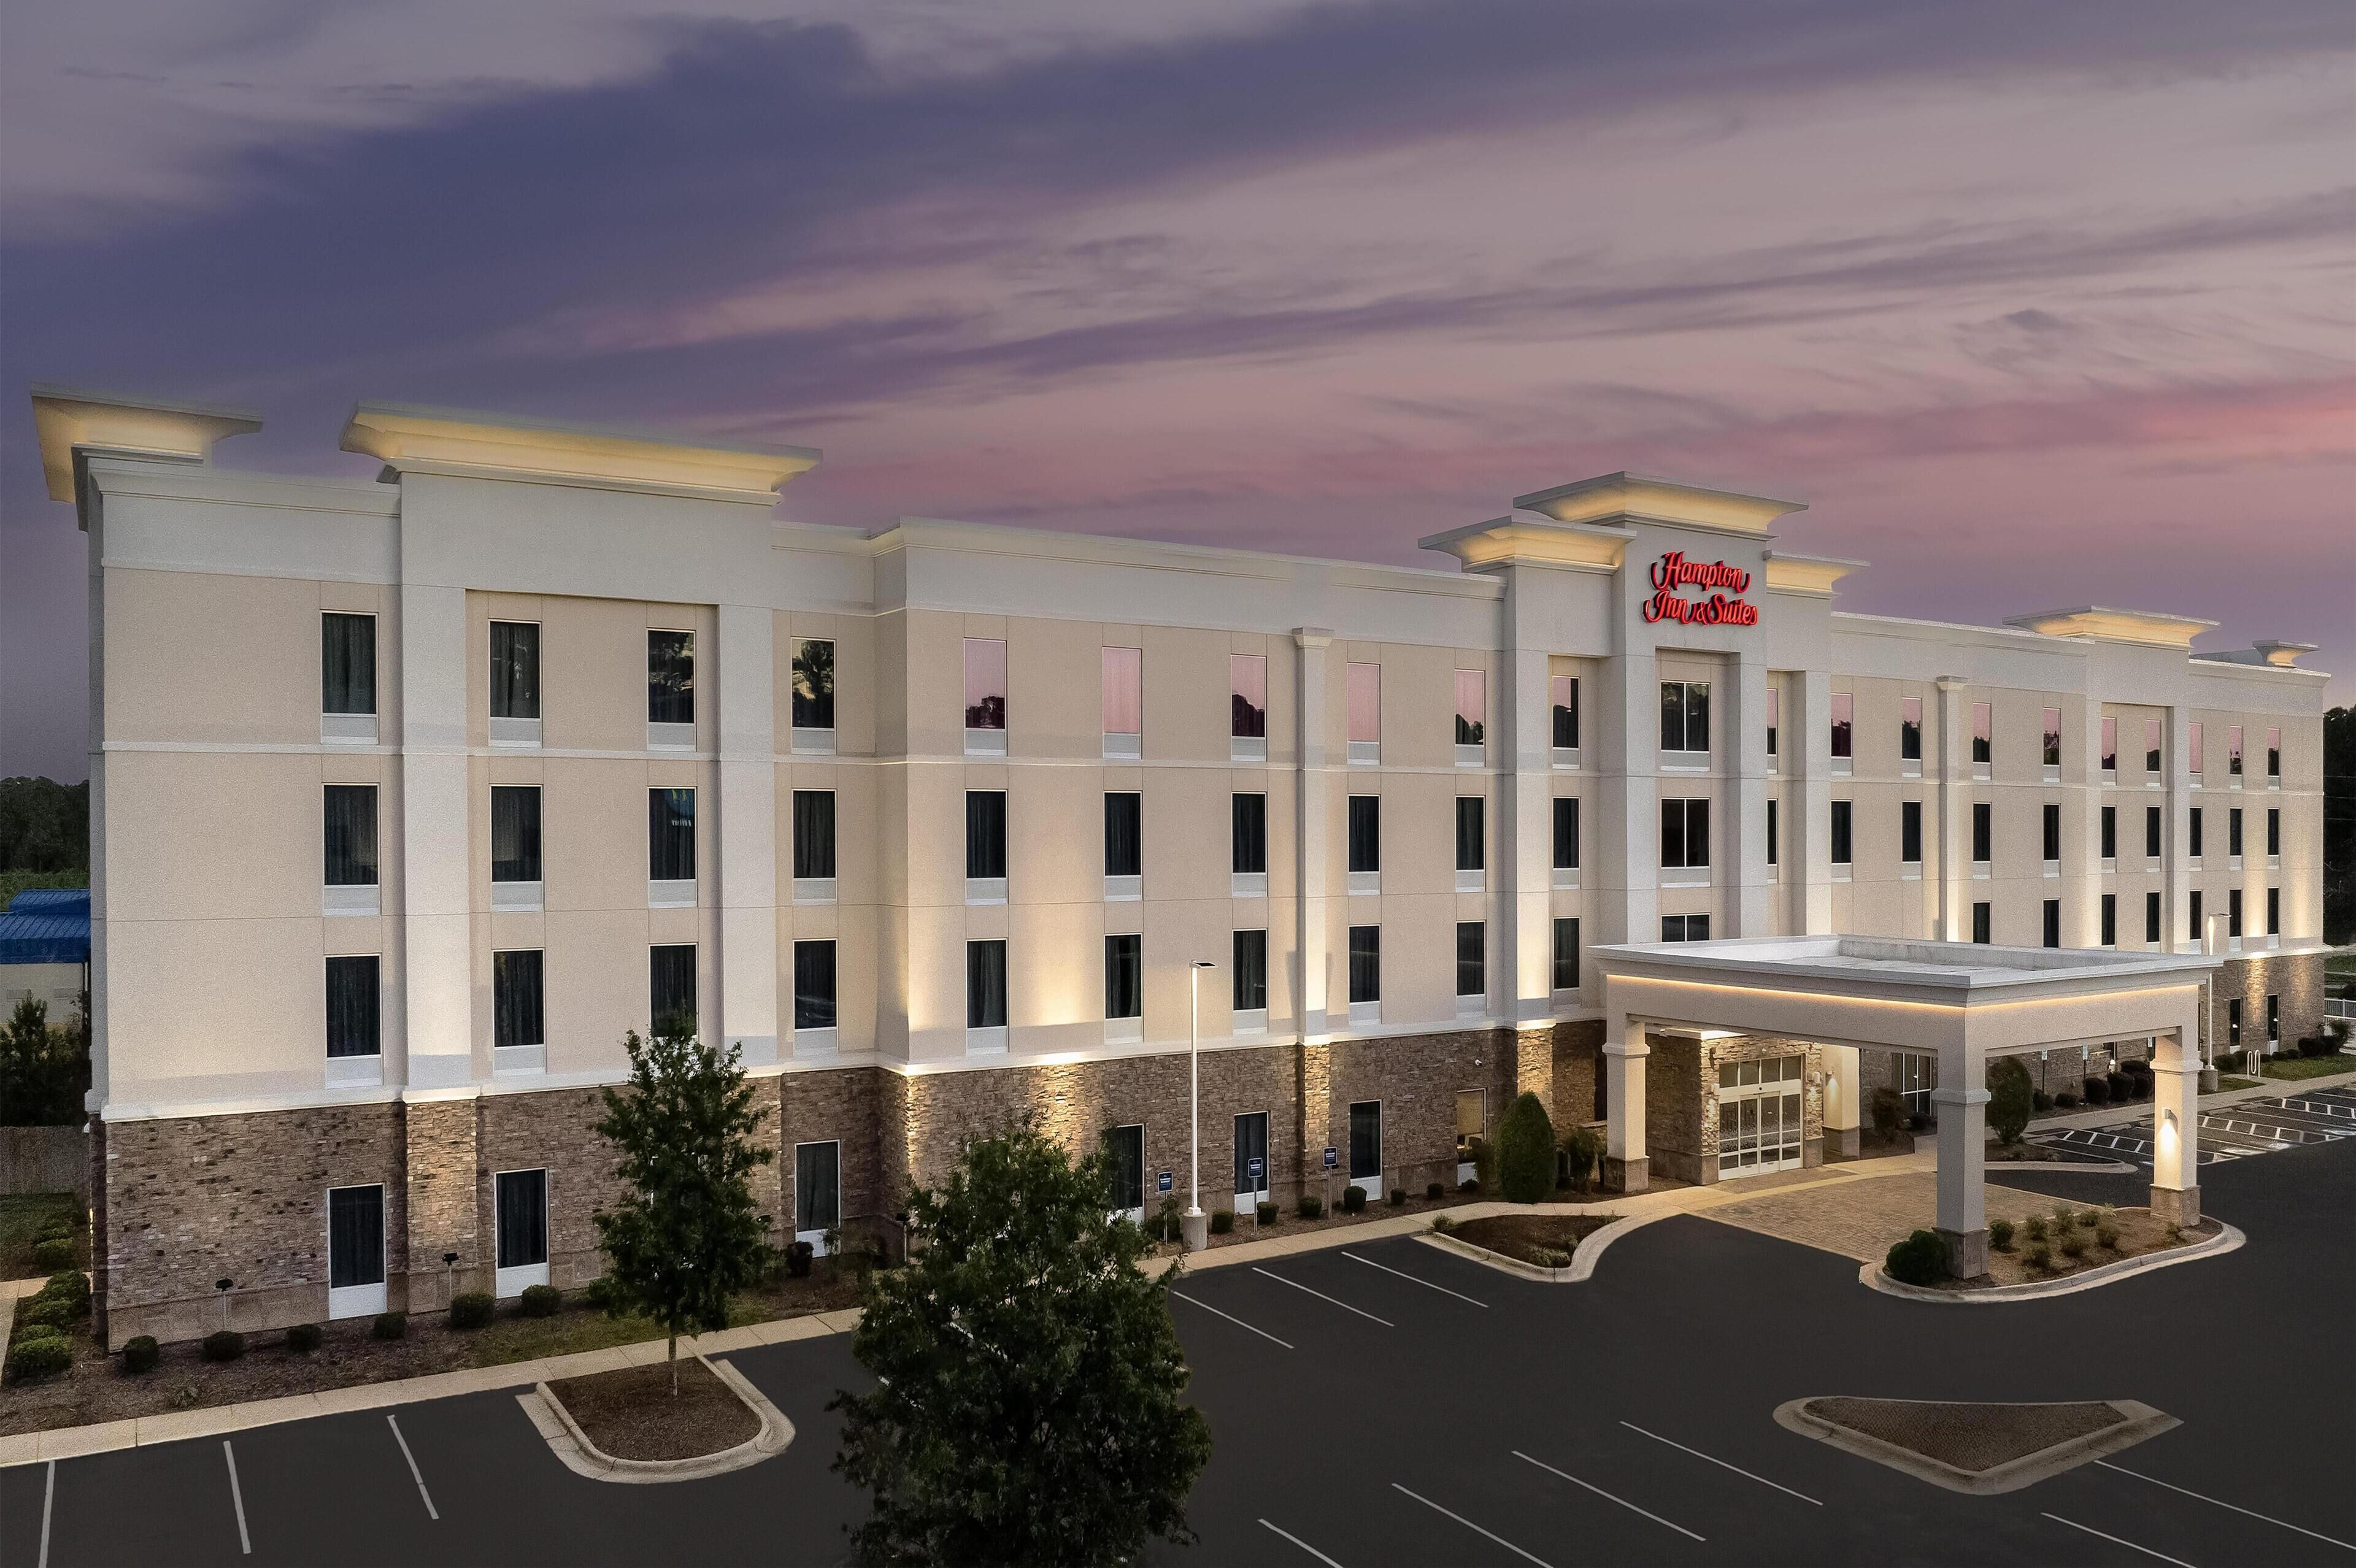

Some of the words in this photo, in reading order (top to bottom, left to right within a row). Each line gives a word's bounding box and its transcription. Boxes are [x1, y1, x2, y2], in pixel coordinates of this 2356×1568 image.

[1650, 551, 1750, 593] Hampton
[1644, 590, 1696, 624] Inn
[1696, 601, 1709, 625] &
[1707, 593, 1758, 625] Suites
